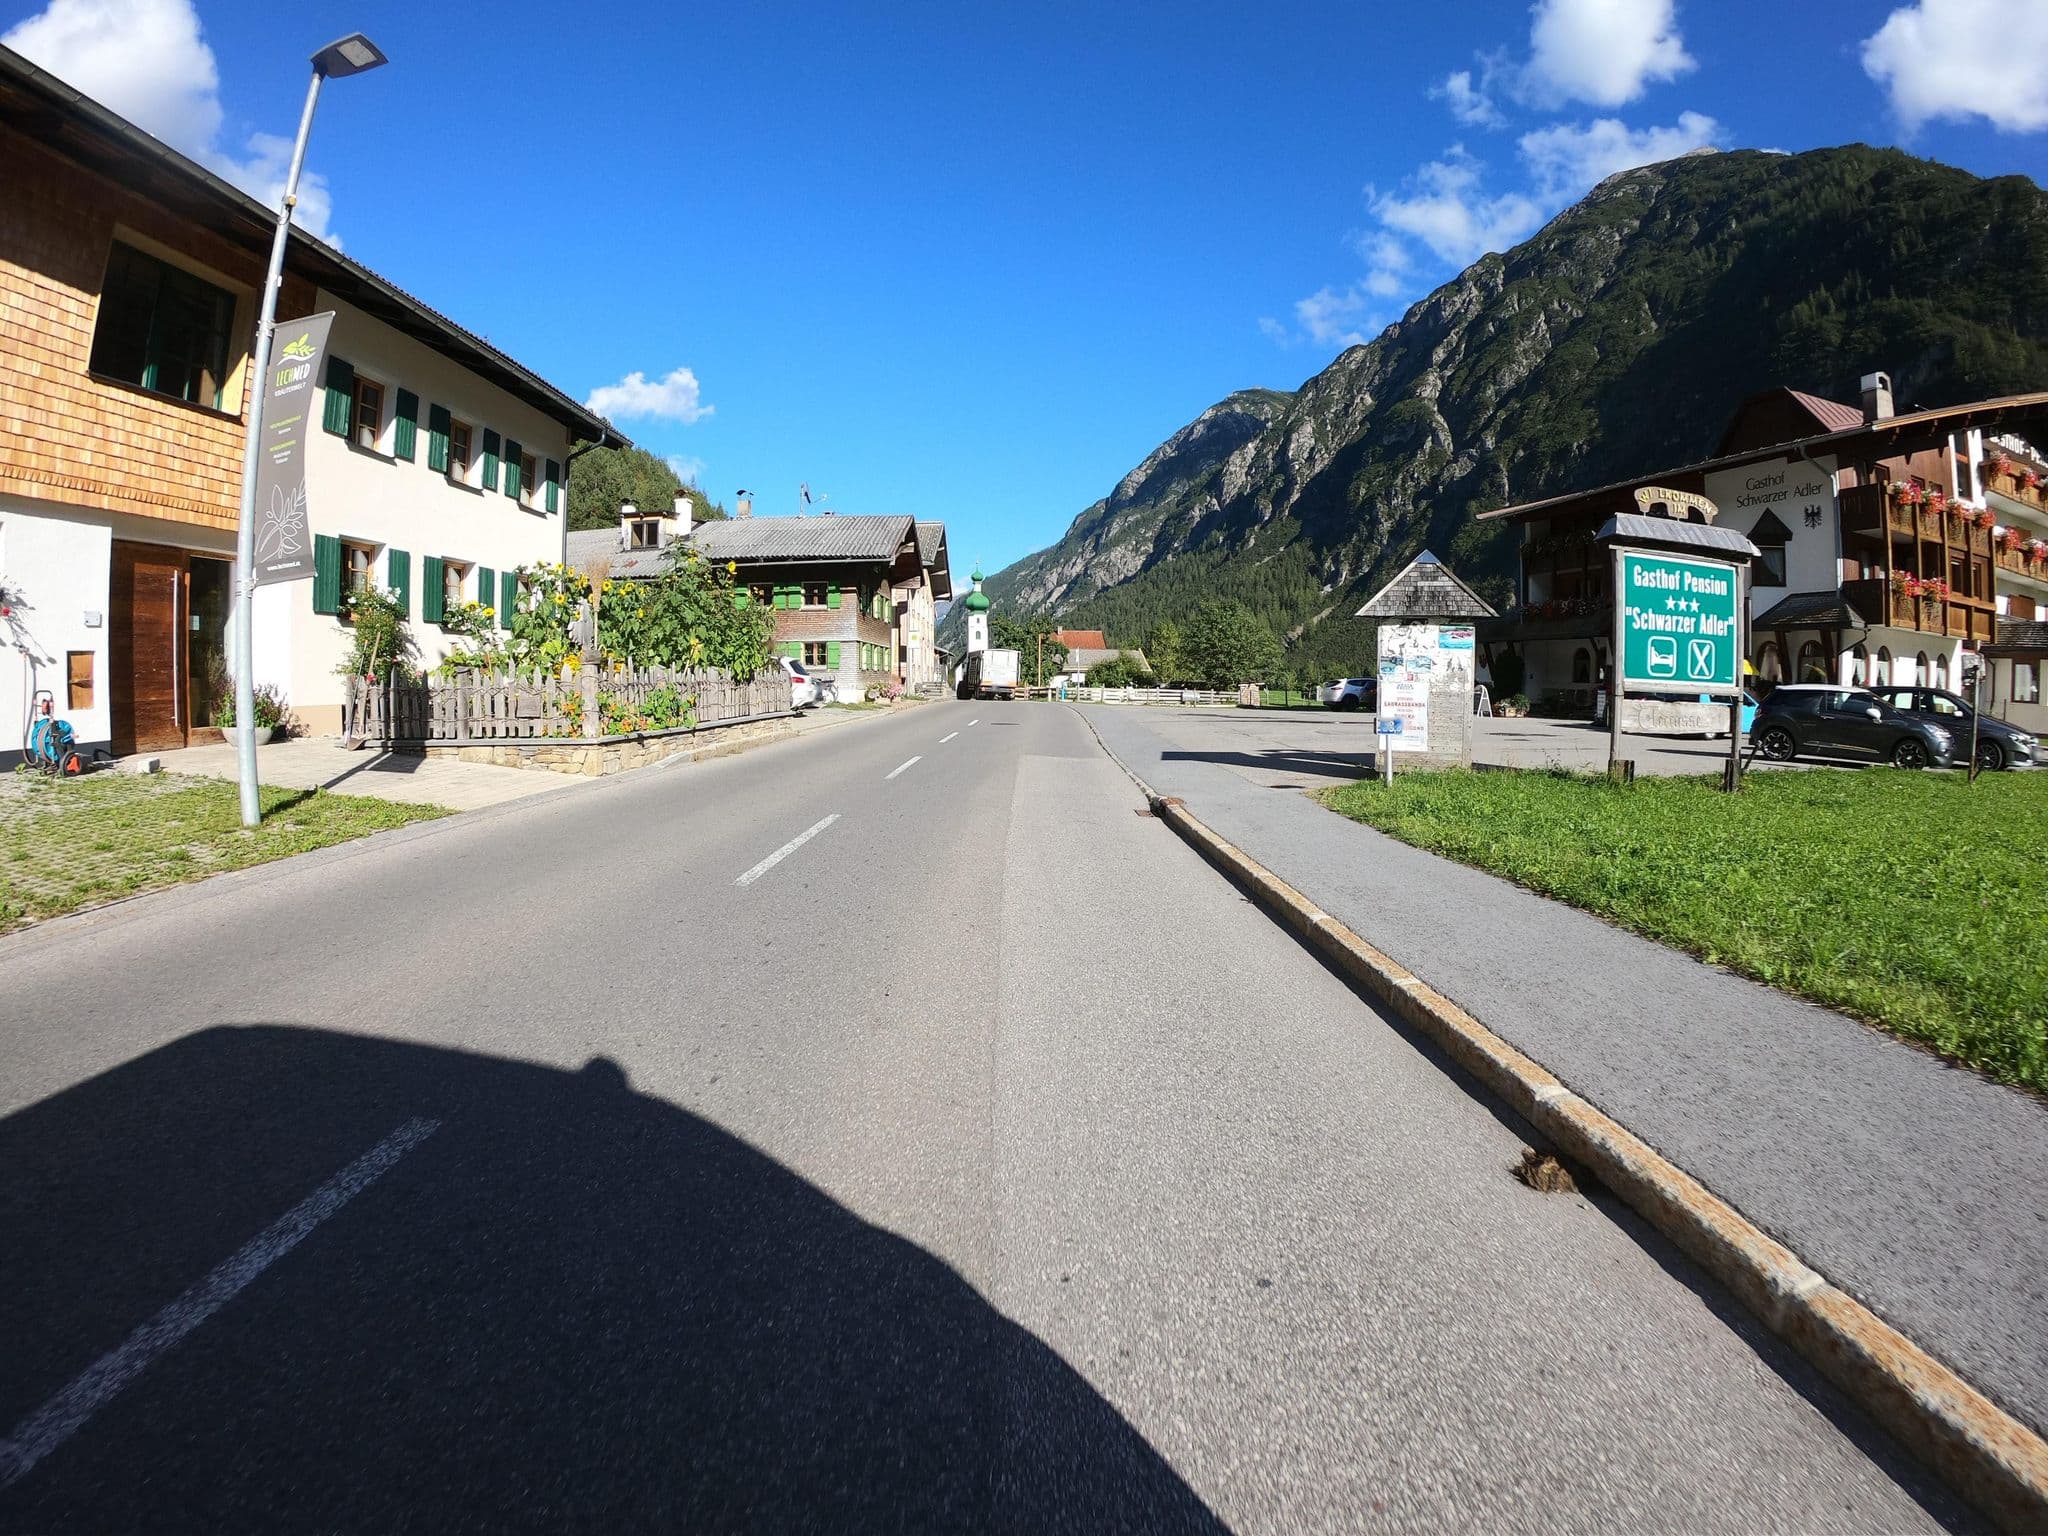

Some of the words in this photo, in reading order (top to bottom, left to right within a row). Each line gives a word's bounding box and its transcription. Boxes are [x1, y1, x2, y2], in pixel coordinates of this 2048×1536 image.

[276, 363, 310, 387] LECHMED
[1746, 472, 1785, 491] Gasthof
[1736, 490, 1788, 508] Schwarzer
[1793, 483, 1824, 498] Adler
[1673, 503, 1686, 515] IM
[1633, 564, 1681, 591] Gasthof
[1683, 572, 1727, 596] Pension
[1625, 605, 1695, 634] "Schwarzer
[1699, 612, 1735, 637] Adler"
